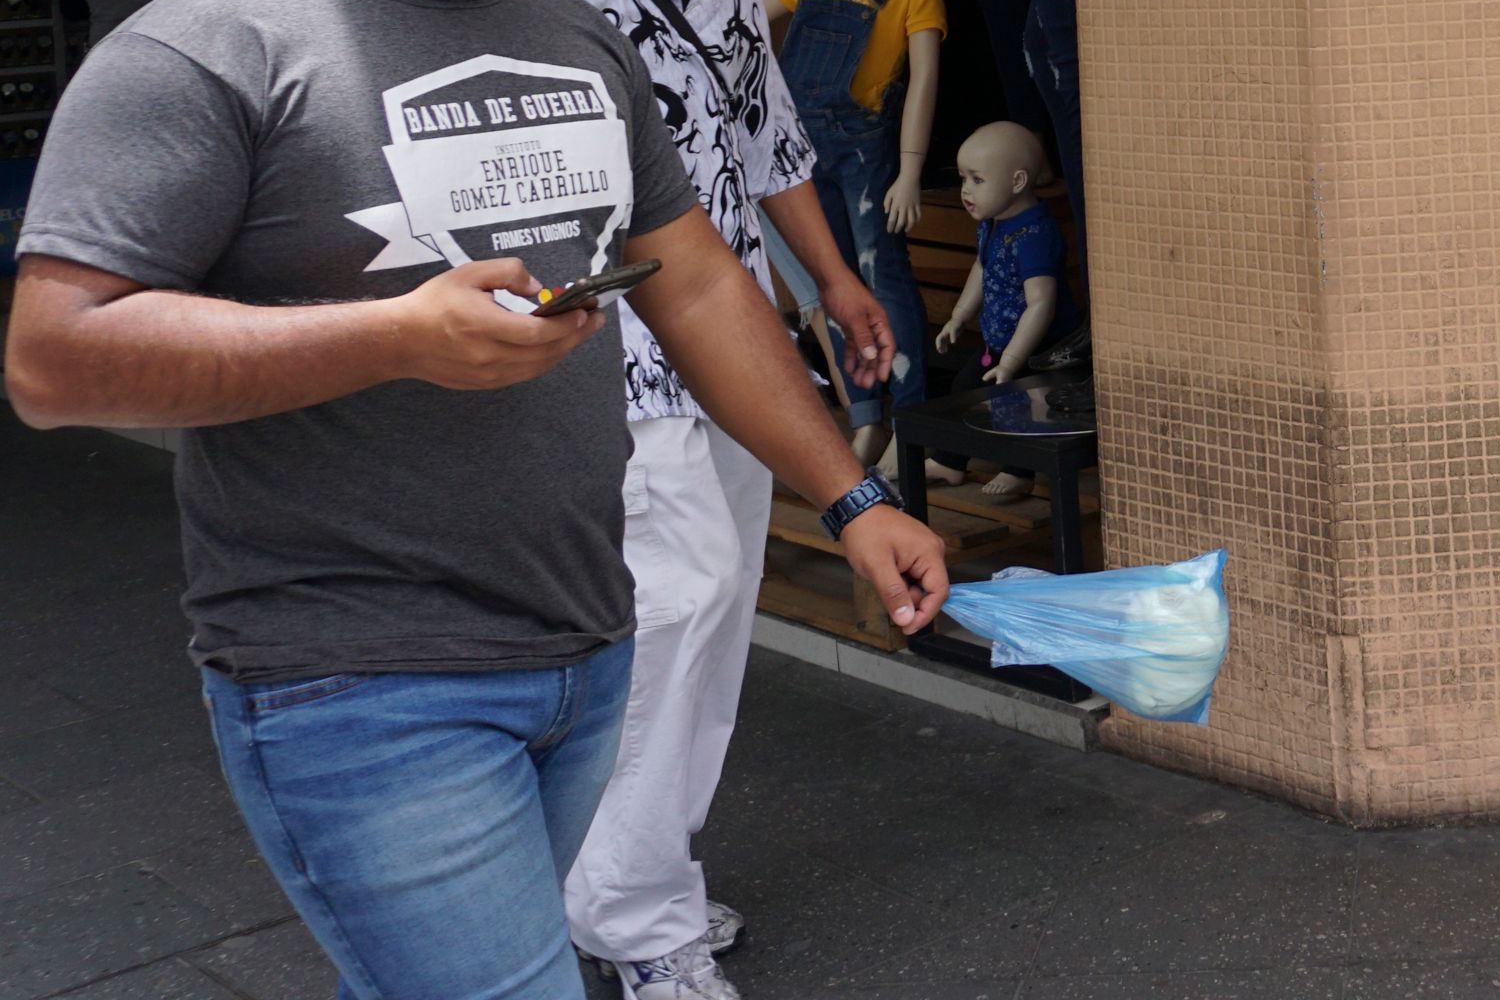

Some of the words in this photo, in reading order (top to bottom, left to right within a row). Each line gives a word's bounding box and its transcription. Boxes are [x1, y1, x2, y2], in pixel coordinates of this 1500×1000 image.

[403, 101, 481, 134] BANDA
[484, 95, 521, 125] DE
[522, 89, 604, 120] GUERRA
[495, 140, 543, 155] INSTITUTO
[480, 150, 567, 183] ENRIQUE
[450, 184, 511, 214] GOMEZ
[517, 170, 609, 205] CARRILLO
[491, 227, 533, 252] FIRMES
[532, 227, 543, 246] Y
[542, 220, 581, 243] DIGNOS
